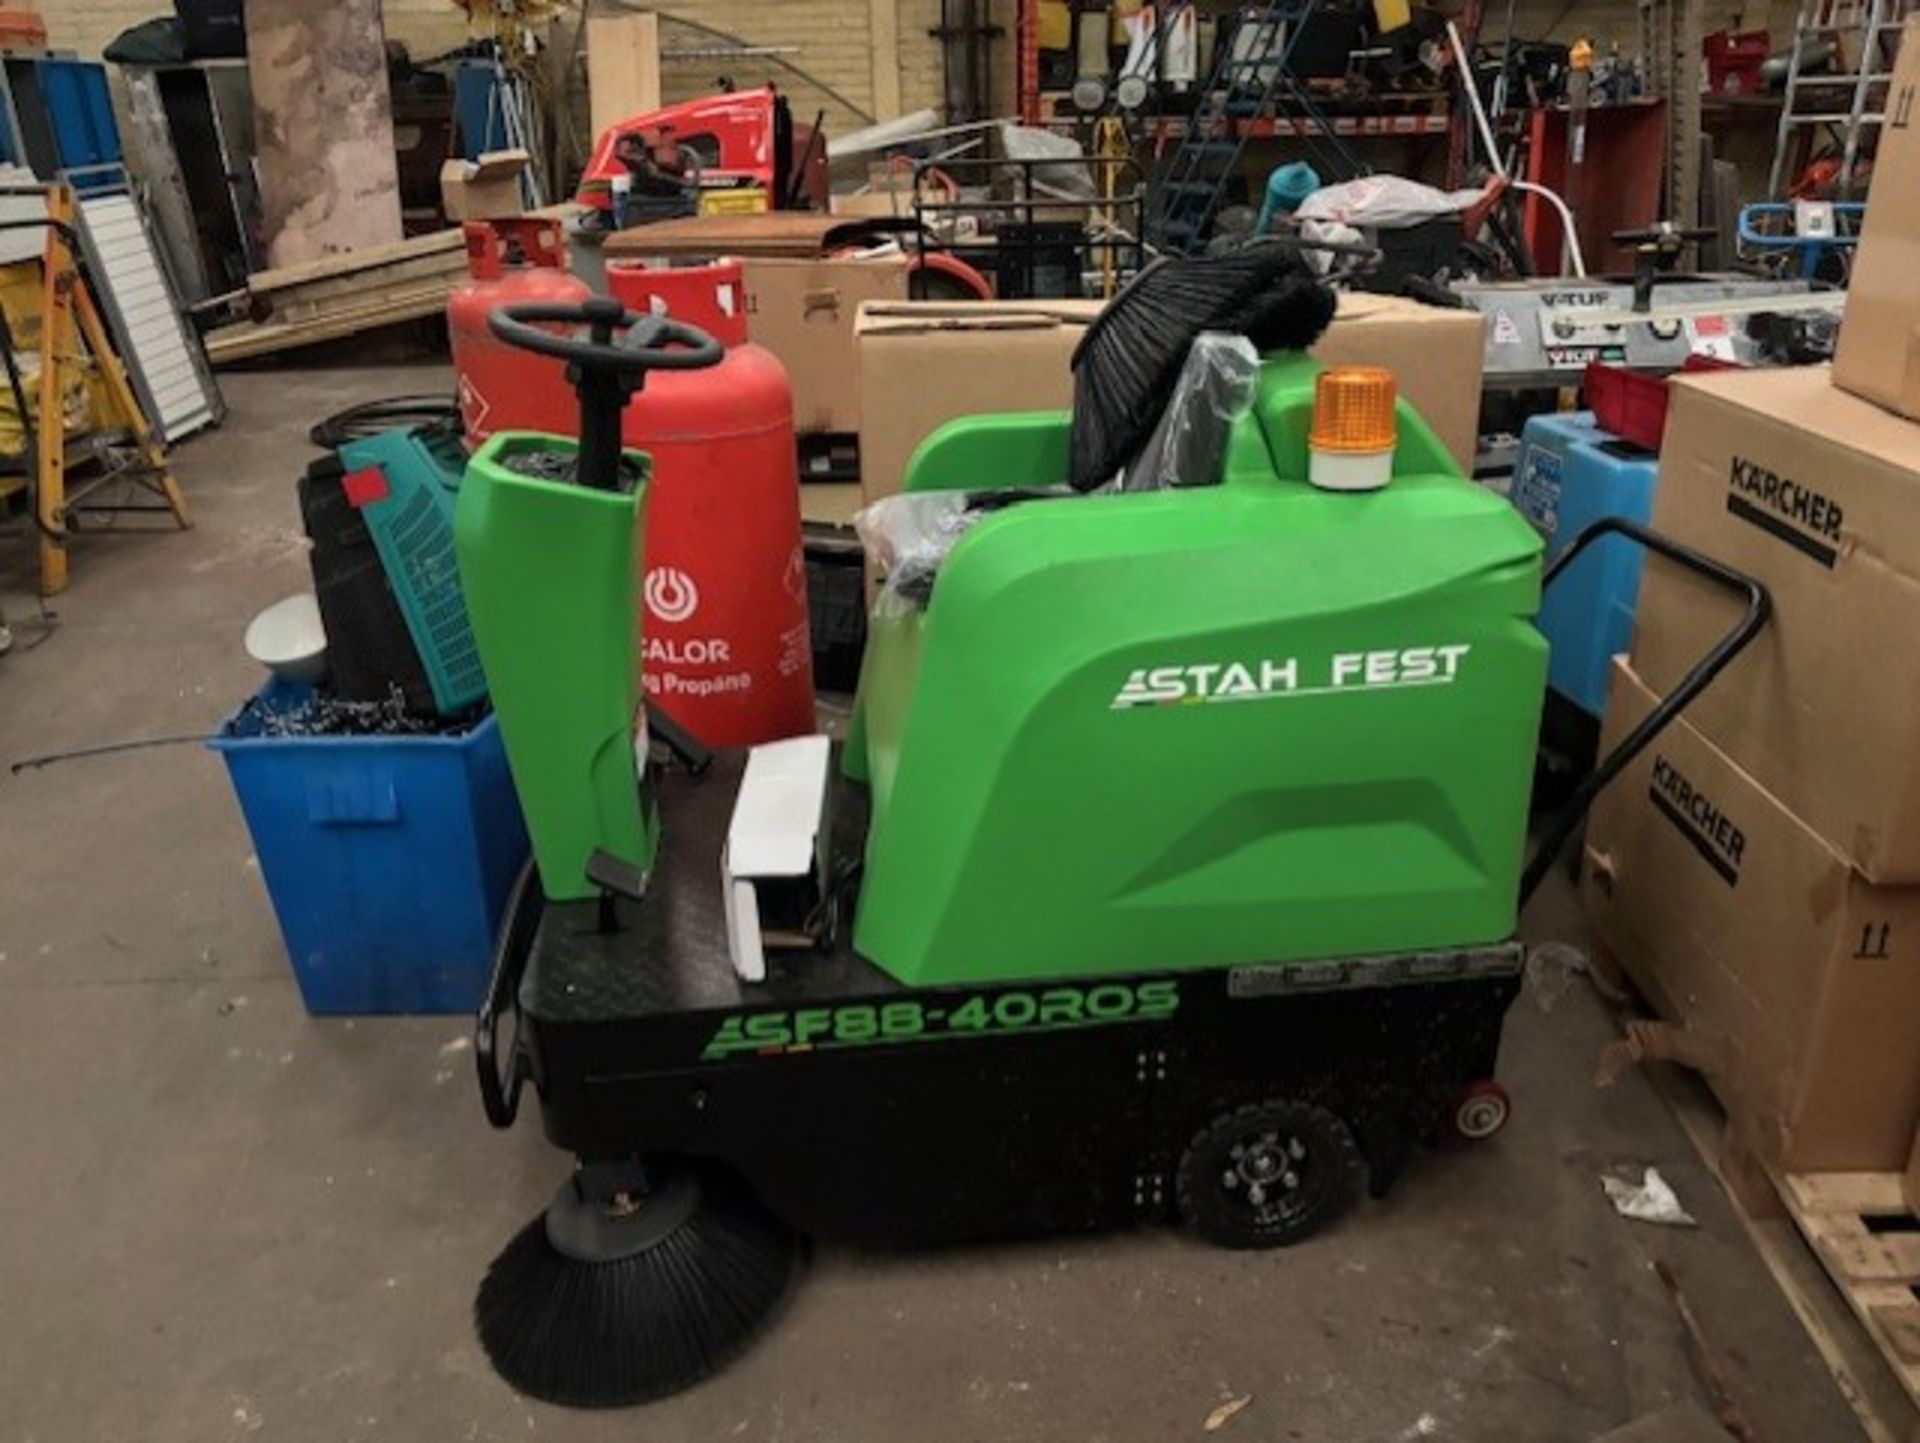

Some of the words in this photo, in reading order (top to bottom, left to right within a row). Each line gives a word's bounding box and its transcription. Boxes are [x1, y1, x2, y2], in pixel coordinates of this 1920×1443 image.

[1730, 455, 1843, 543] KÄRCHER
[662, 672, 751, 697] Propane
[1332, 644, 1472, 686] FEST
